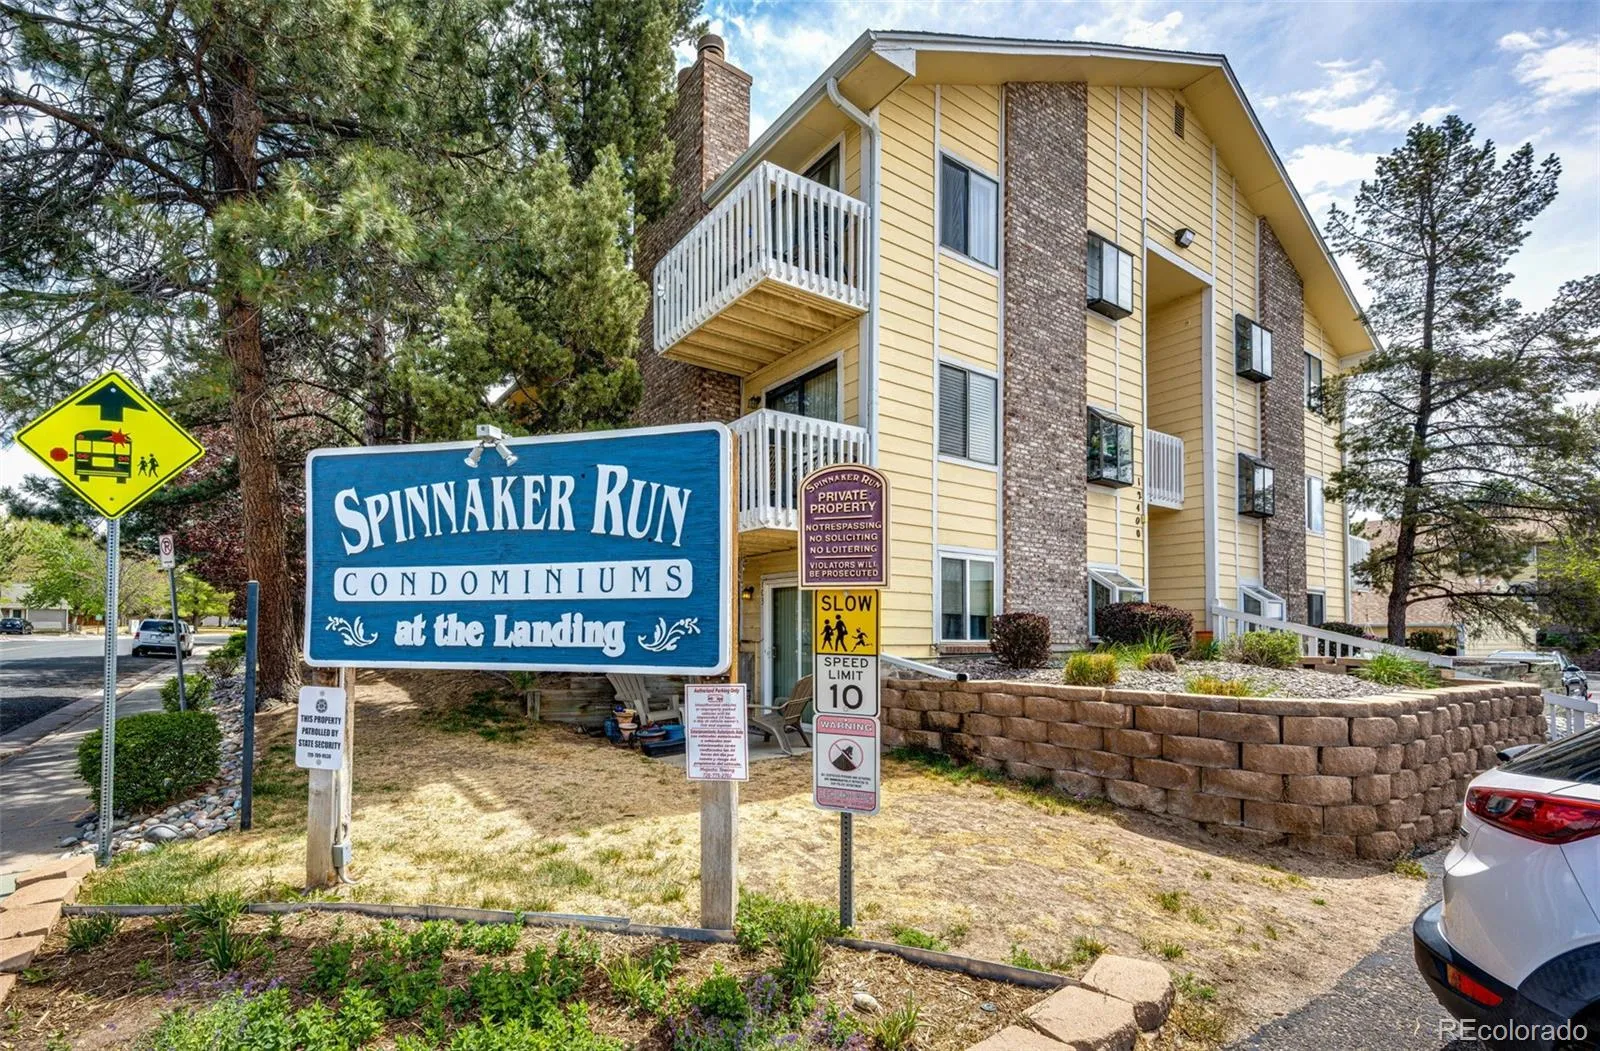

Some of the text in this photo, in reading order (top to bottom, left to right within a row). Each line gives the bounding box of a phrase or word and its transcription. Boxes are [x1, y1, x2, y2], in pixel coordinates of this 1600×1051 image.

[806, 473, 882, 493] SPINNAKER RUN
[818, 489, 868, 502] PRIVATE
[334, 464, 692, 555] SPINNAKER RUN
[810, 501, 876, 514] PROPERTY
[810, 532, 878, 542] NO SOLICITING
[810, 544, 878, 554] NO LOITERING
[810, 560, 878, 569] VIOLATORS WILL
[822, 569, 878, 577] PROSECUTED
[343, 565, 682, 596] CONDOMINIUMS
[821, 595, 872, 612] SLOW
[394, 612, 626, 658] at the Landing
[824, 656, 869, 668] SPEED
[828, 670, 864, 680] LIMIT
[830, 684, 863, 710] 10
[301, 714, 341, 725] THIS PROPERTY
[302, 727, 330, 737] PATROLLED
[820, 720, 872, 732] WARNING
[298, 739, 341, 750] STATE SECURITY
